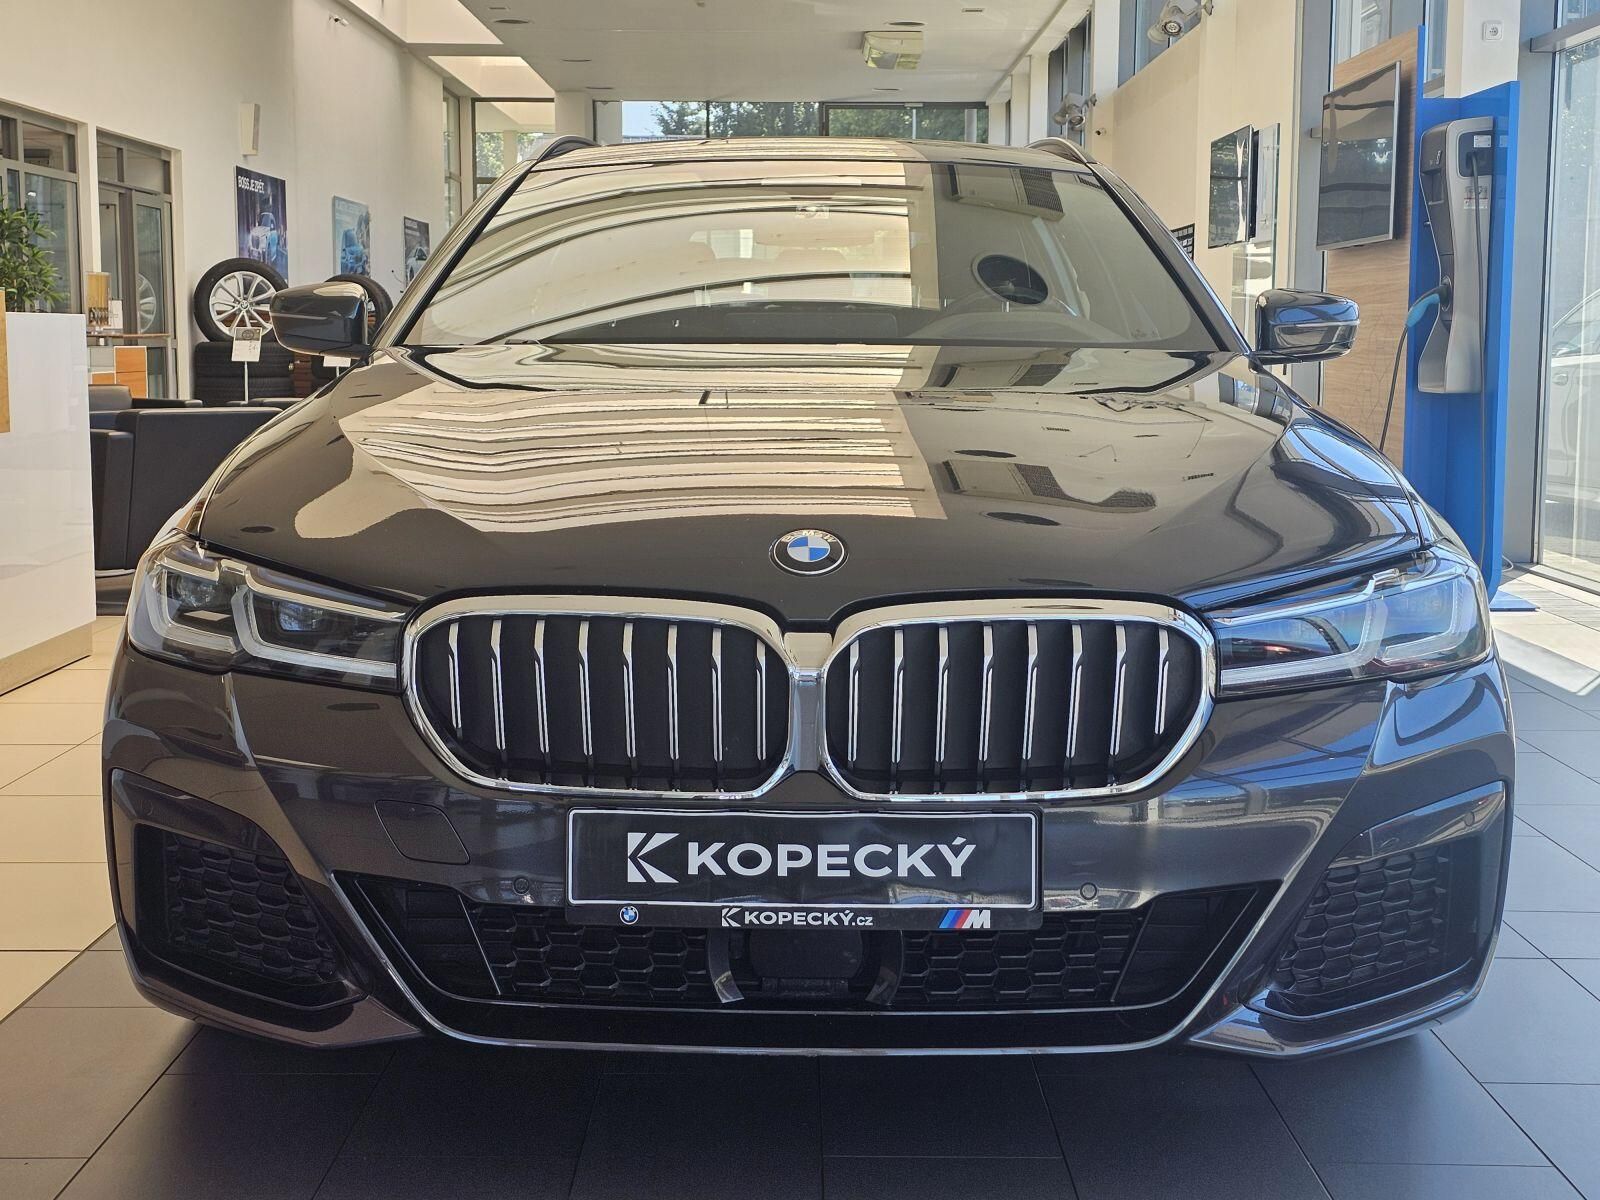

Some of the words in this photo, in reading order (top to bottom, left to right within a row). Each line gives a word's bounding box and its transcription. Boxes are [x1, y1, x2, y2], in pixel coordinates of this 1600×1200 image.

[237, 175, 249, 190] BOSS
[688, 837, 977, 877] KOPECKÝ
[961, 909, 990, 928] M
